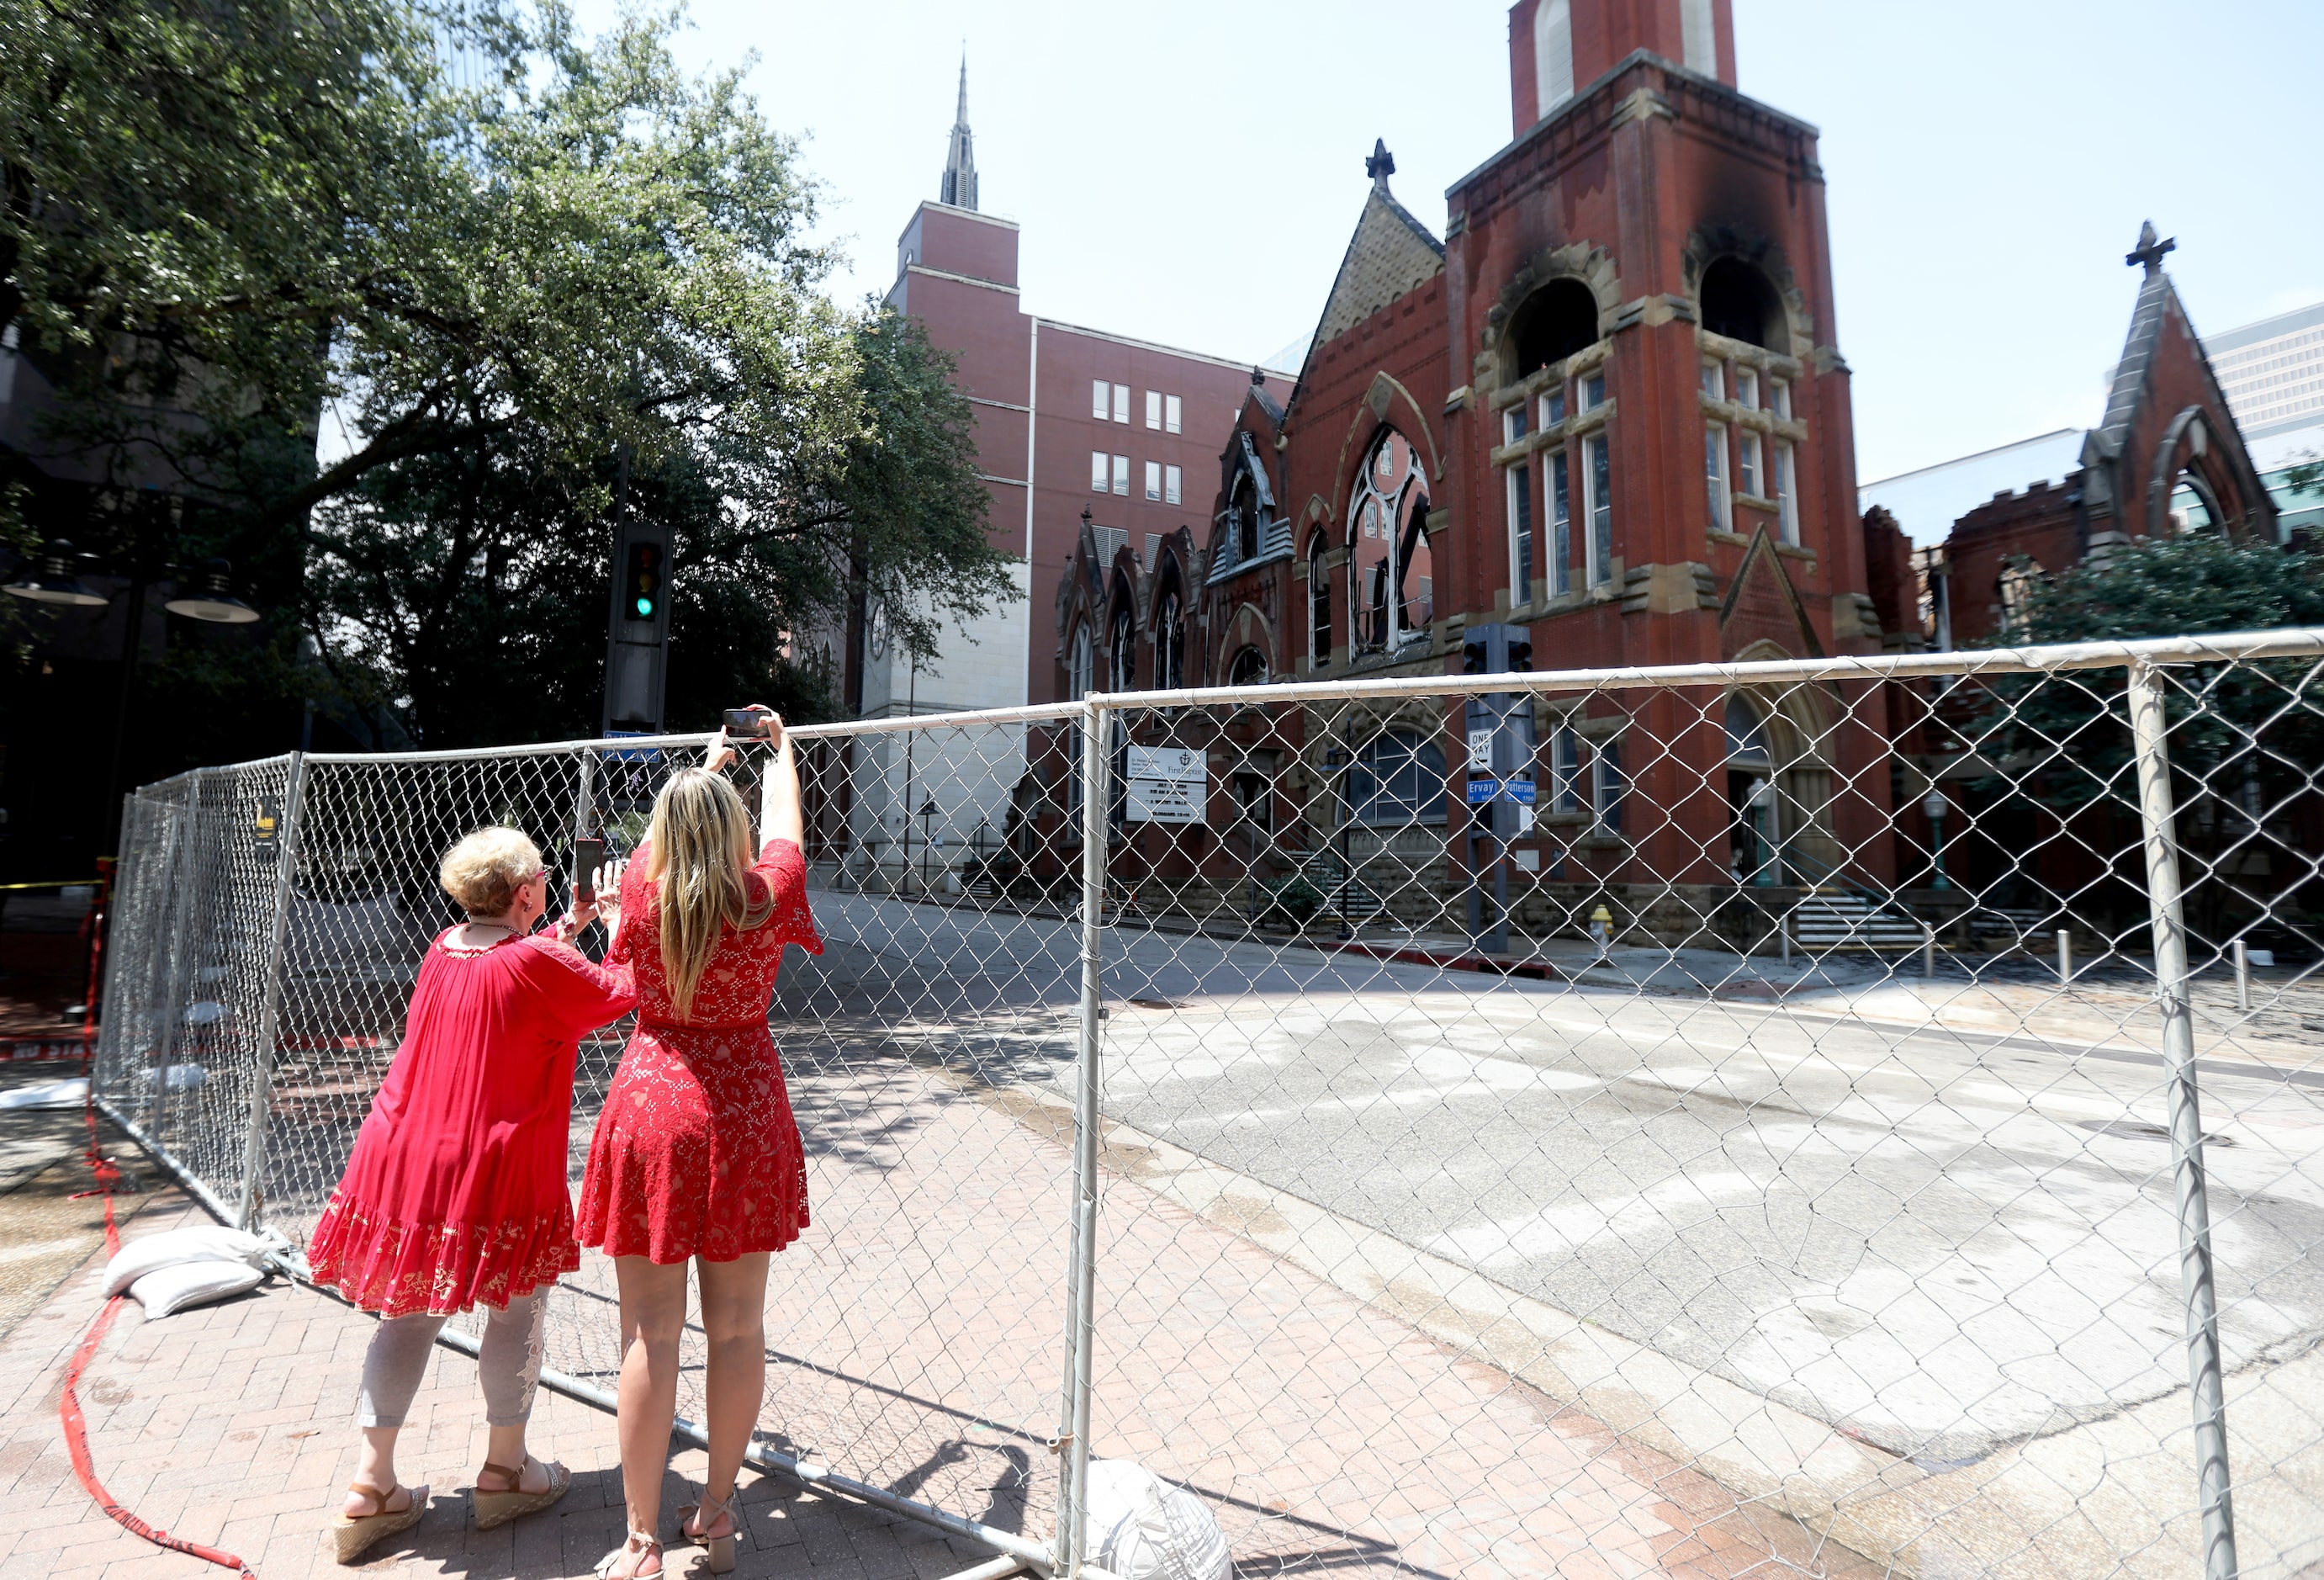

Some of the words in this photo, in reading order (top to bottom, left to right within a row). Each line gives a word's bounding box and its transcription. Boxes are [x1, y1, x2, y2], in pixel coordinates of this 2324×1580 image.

[1473, 734, 1489, 745] ONE
[1472, 745, 1490, 755] WAY
[1469, 783, 1494, 793] Ervay
[1506, 782, 1535, 793] Patterson
